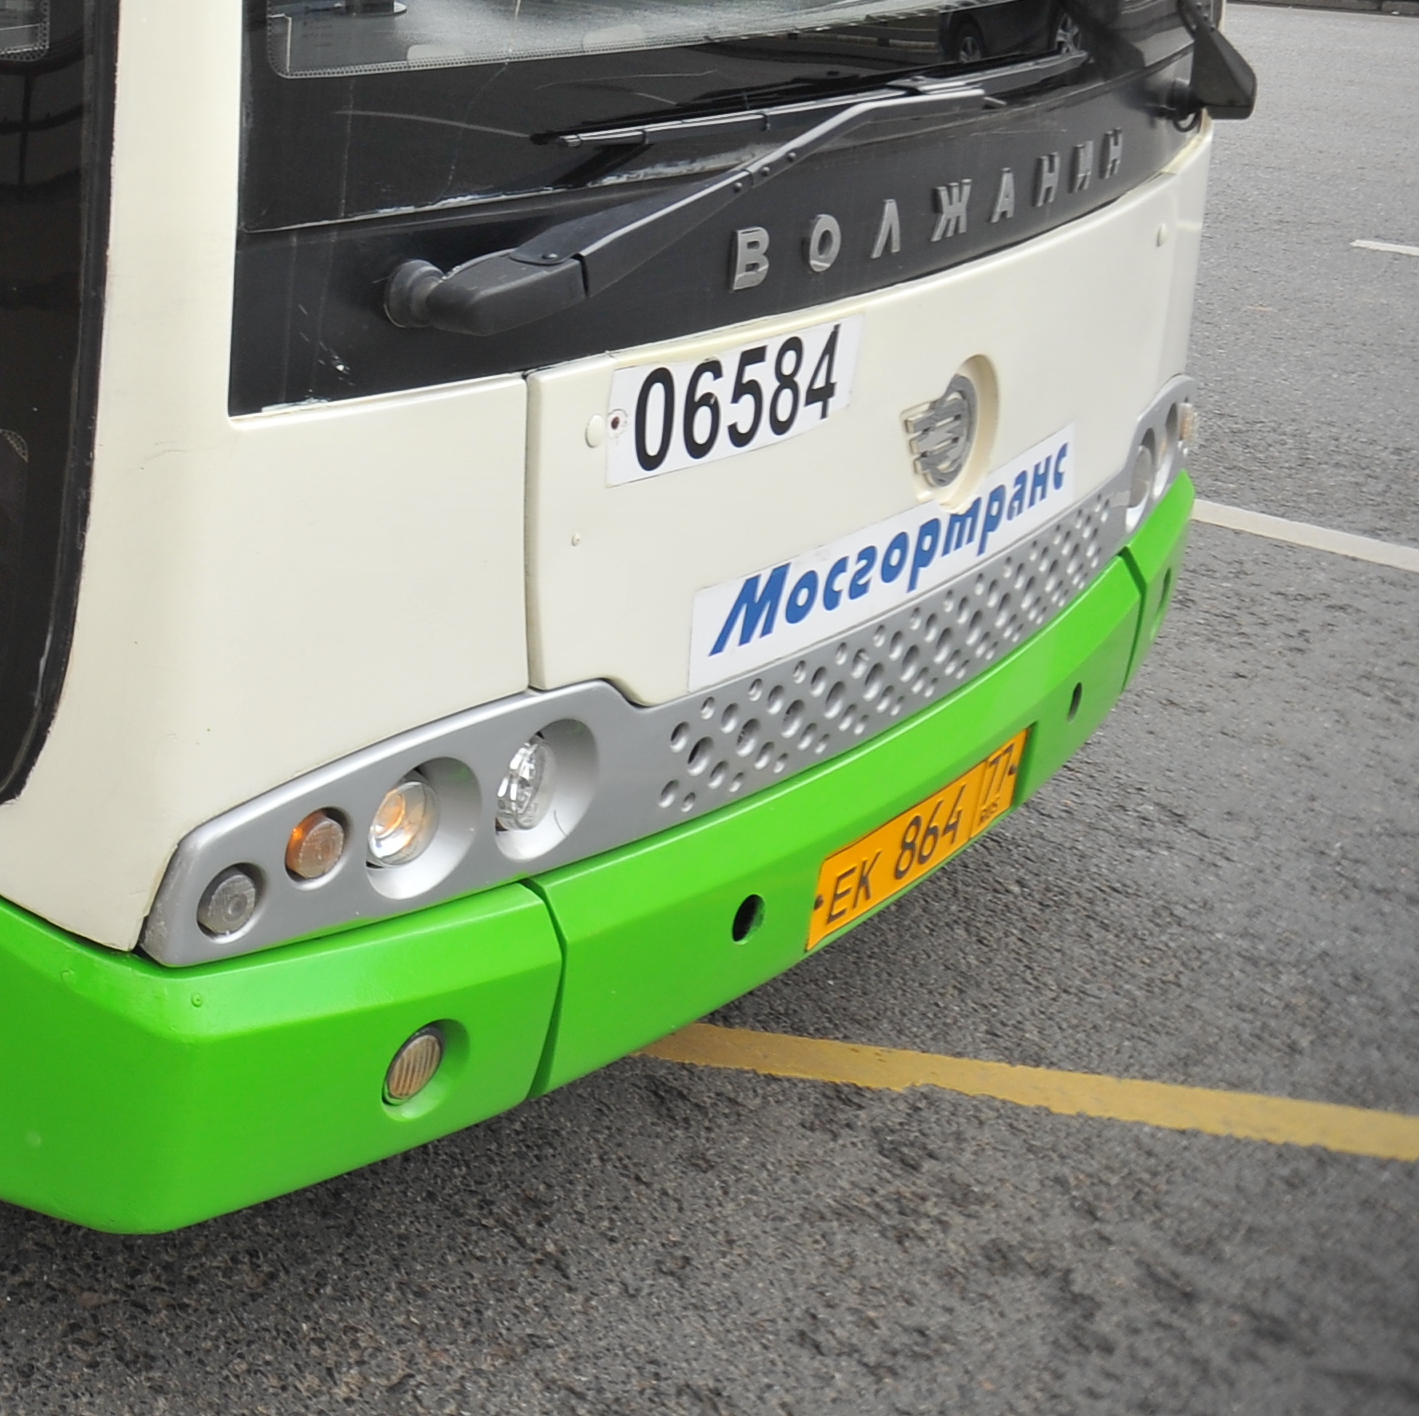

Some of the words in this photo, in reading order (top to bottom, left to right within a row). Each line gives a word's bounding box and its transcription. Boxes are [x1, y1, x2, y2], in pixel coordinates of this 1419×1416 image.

[732, 130, 1123, 290] ВОЛЖАНИН
[634, 323, 839, 472] 06584
[708, 441, 1069, 659] Мосгортранс
[893, 782, 967, 881] 864
